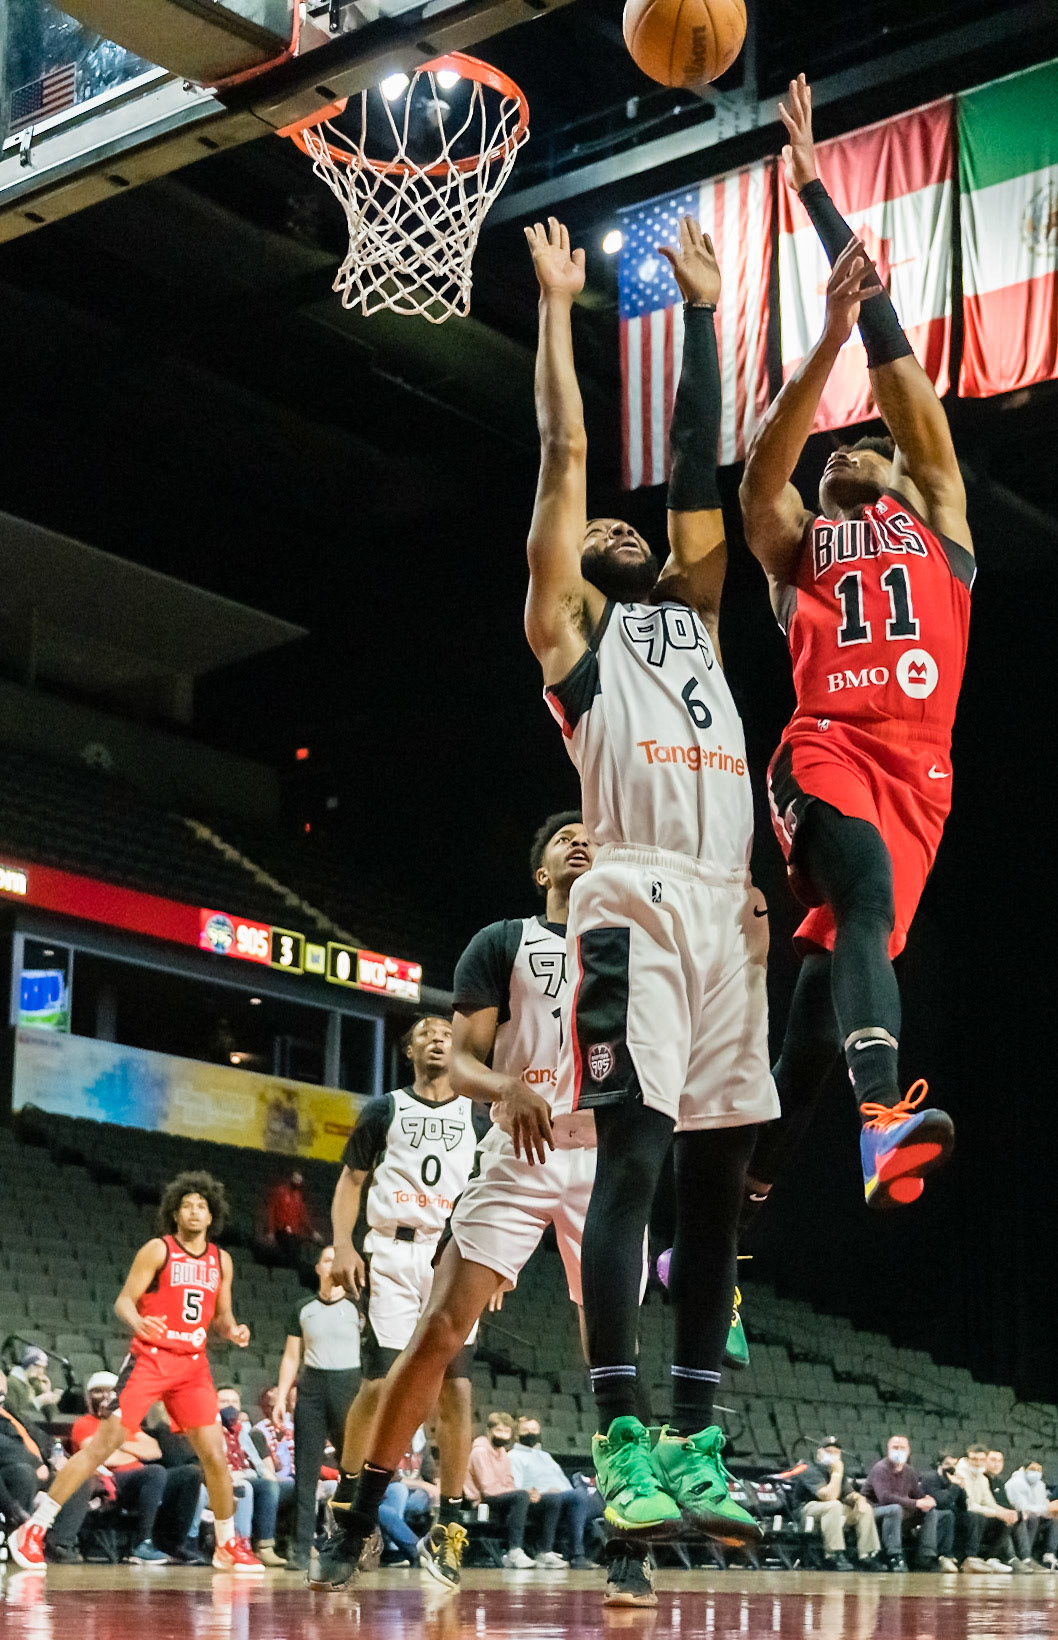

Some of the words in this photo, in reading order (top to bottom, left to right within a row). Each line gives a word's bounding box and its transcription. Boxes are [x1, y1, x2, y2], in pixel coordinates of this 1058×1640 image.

[812, 513, 928, 579] BULLS
[834, 564, 920, 648] 11
[826, 666, 890, 694] BMO
[681, 676, 713, 729] 6
[636, 739, 745, 777] Tangerine
[236, 924, 269, 958] 905
[279, 935, 294, 967] 3
[336, 950, 351, 981] 0
[591, 1058, 610, 1075] 905
[401, 1117, 466, 1152] 905
[421, 1154, 442, 1187] 0
[170, 1260, 219, 1293] BULLS
[182, 1288, 204, 1325] 5
